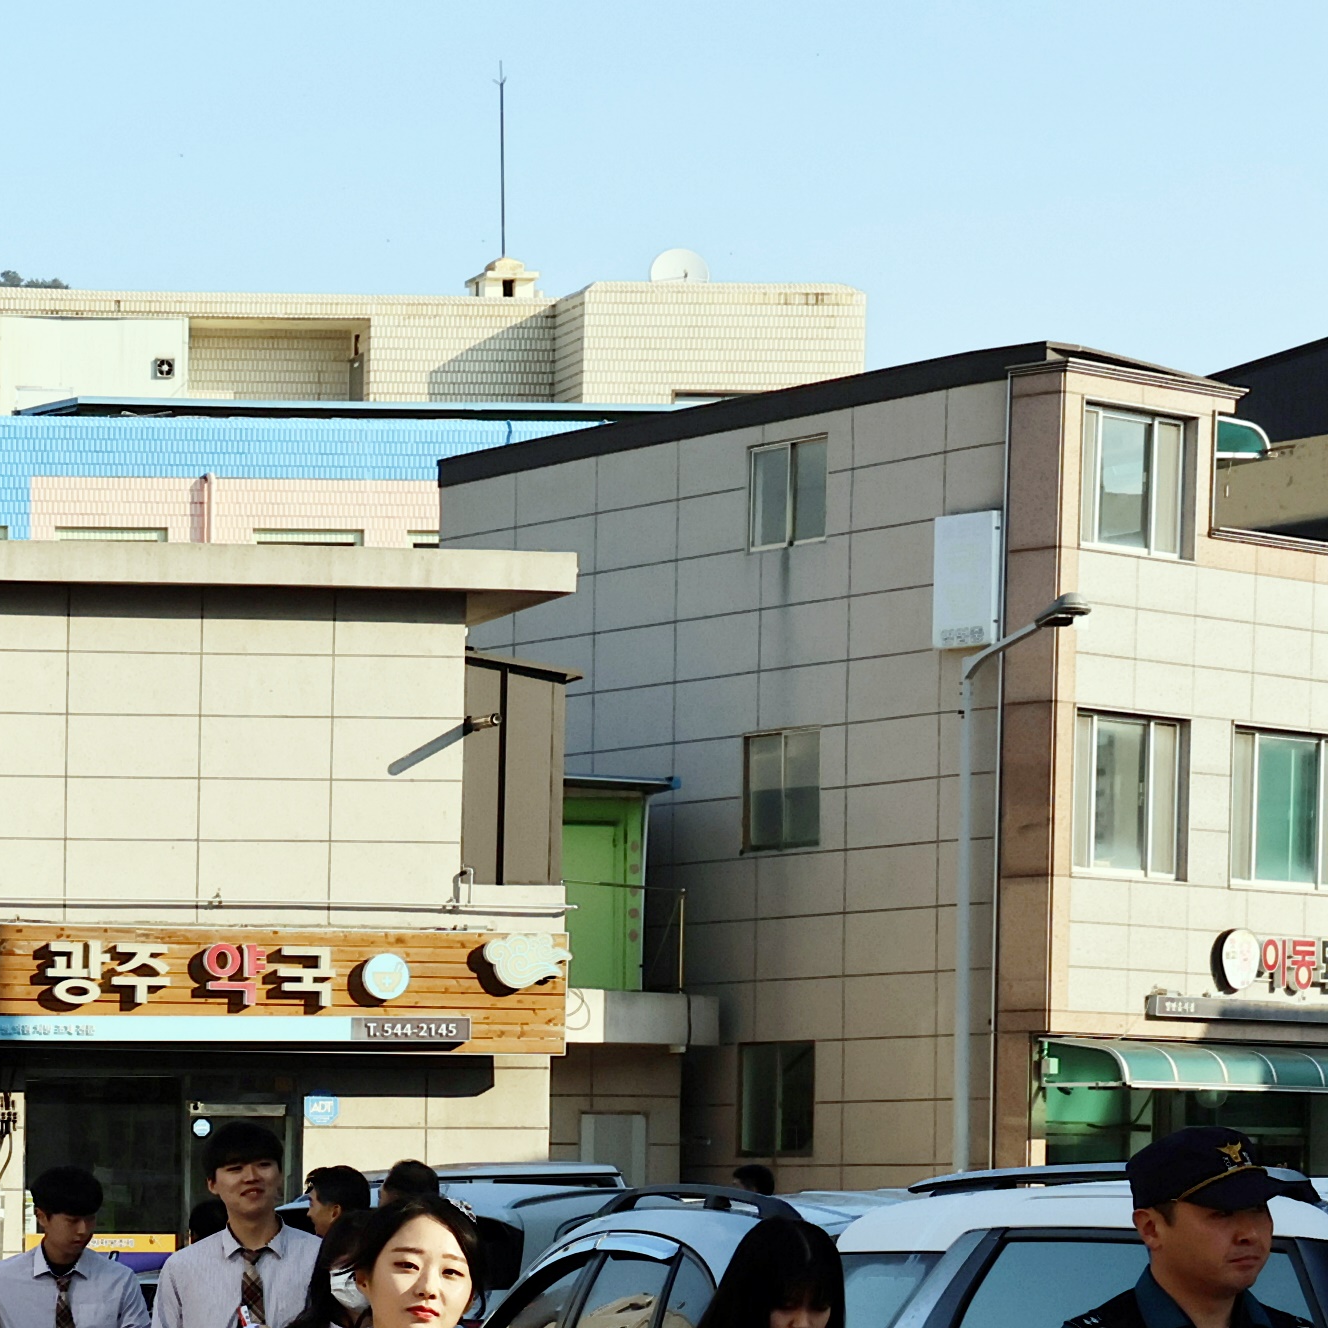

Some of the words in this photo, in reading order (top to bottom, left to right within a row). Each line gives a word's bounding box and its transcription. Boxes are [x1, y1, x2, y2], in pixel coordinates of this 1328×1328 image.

[46, 940, 171, 1005] 광주
[203, 941, 336, 1007] 약국
[366, 1022, 380, 1037] T.
[382, 1021, 458, 1038] 544-2145
[310, 1102, 334, 1115] ADT
